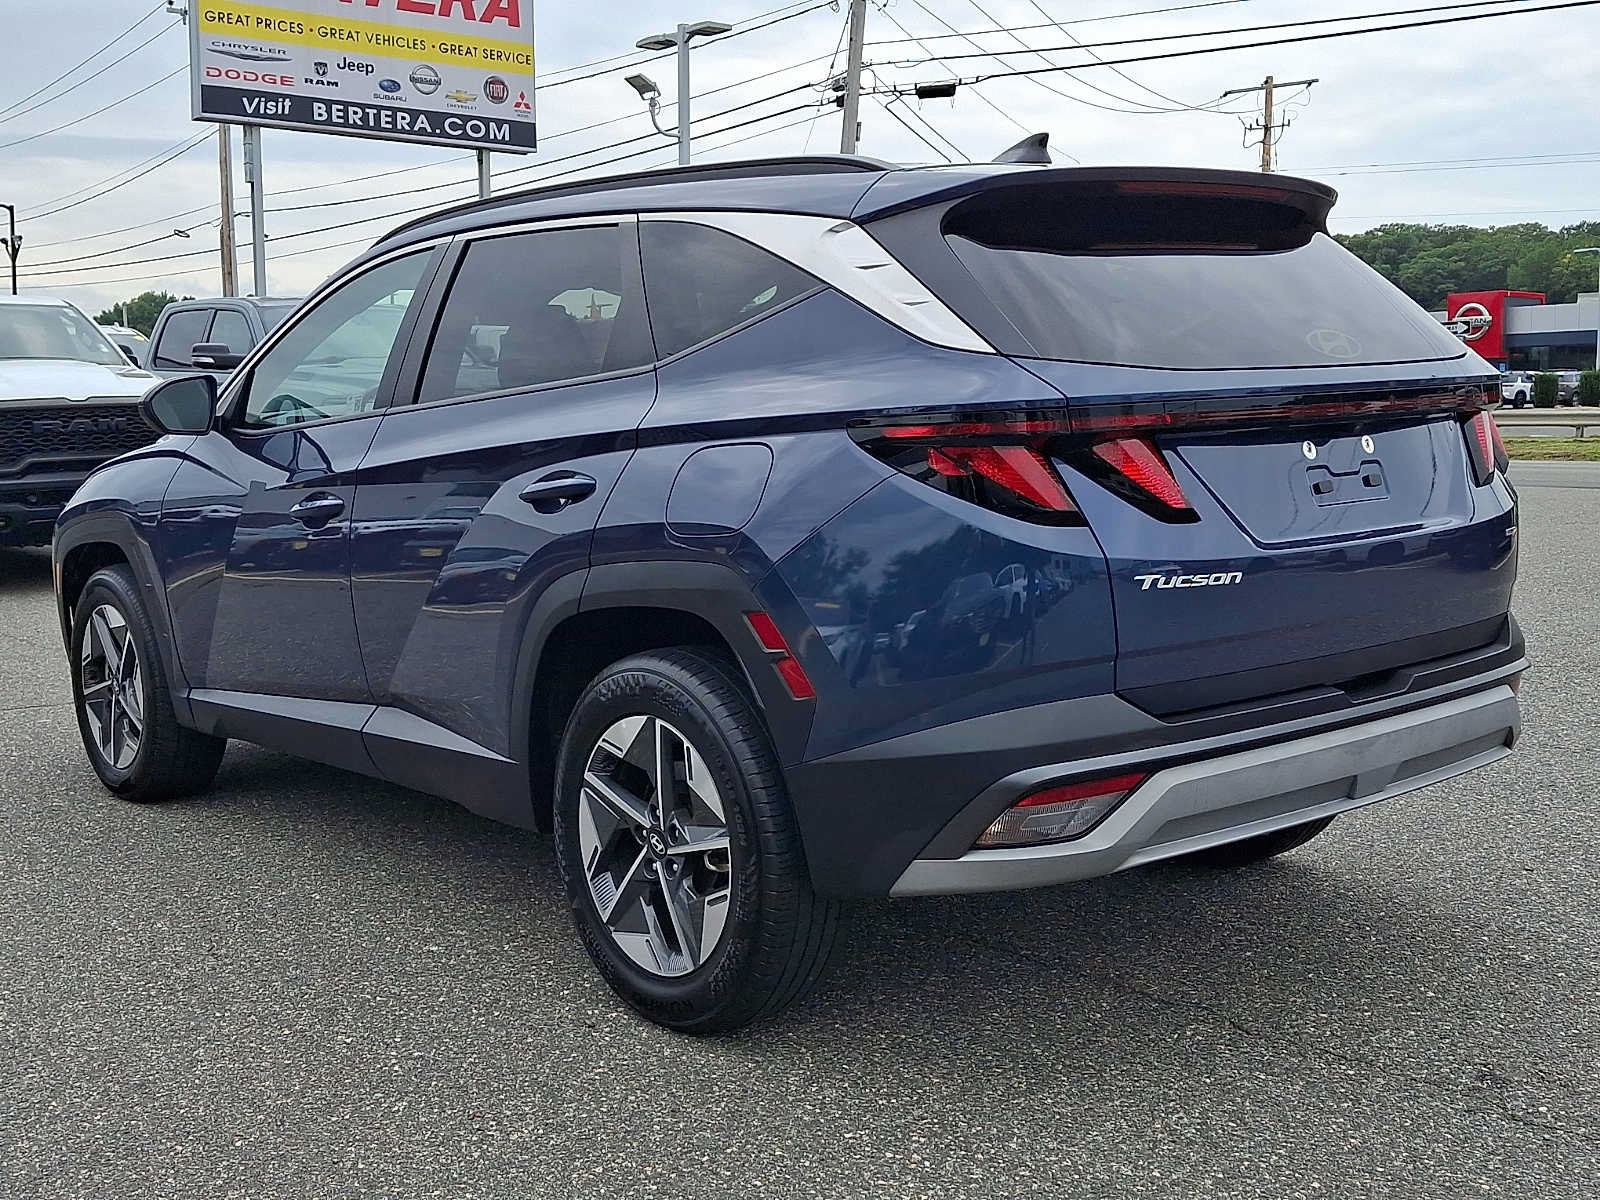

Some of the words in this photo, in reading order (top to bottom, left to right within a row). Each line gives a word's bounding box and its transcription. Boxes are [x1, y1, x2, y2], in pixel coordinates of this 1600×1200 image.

[204, 10, 251, 27] GREAT
[256, 17, 304, 34] PRICES
[317, 26, 361, 42] GREAT
[365, 32, 426, 50] VEHICLES
[438, 42, 478, 58] GREAT
[483, 48, 532, 66] SERVICE
[211, 41, 287, 55] CHRYSLER
[336, 57, 375, 76] Jeep
[205, 67, 295, 86] DODGE
[304, 78, 339, 87] RAM
[412, 75, 439, 84] NISSAN
[373, 93, 407, 102] SUBARU
[242, 97, 292, 114] Visit
[312, 102, 510, 141] BERTERA.COM
